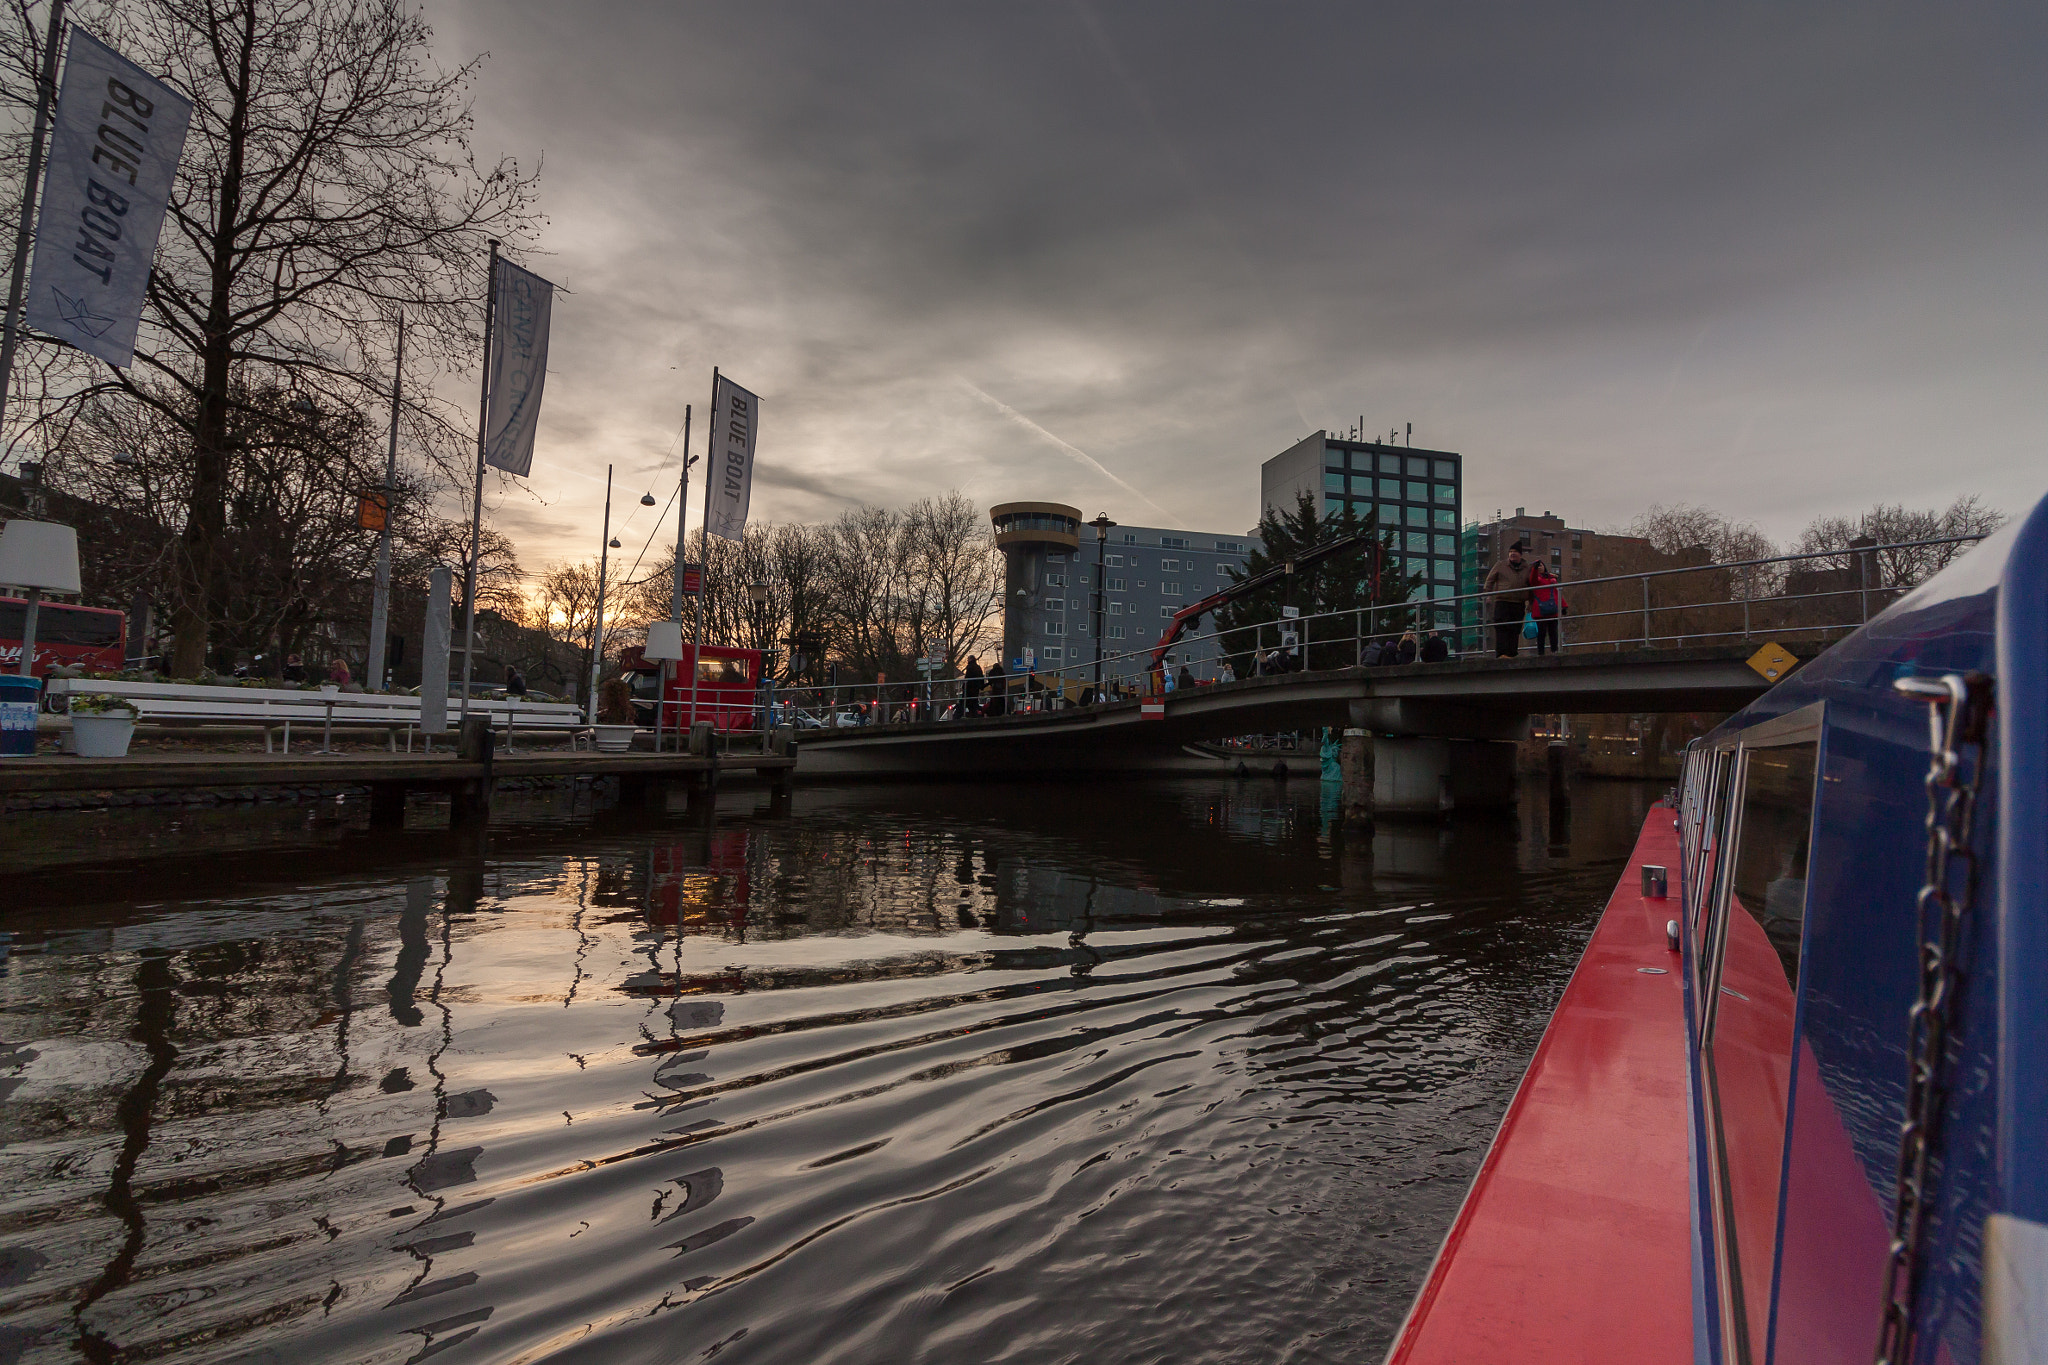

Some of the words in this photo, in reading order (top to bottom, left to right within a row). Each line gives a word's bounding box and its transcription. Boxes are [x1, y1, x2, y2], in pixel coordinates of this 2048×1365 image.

[92, 76, 154, 186] BLUE
[73, 177, 130, 286] BOAT
[511, 278, 532, 360] CANAL
[501, 370, 530, 463] CRUISES
[728, 395, 747, 448] BLUE
[724, 450, 745, 503] BOAT
